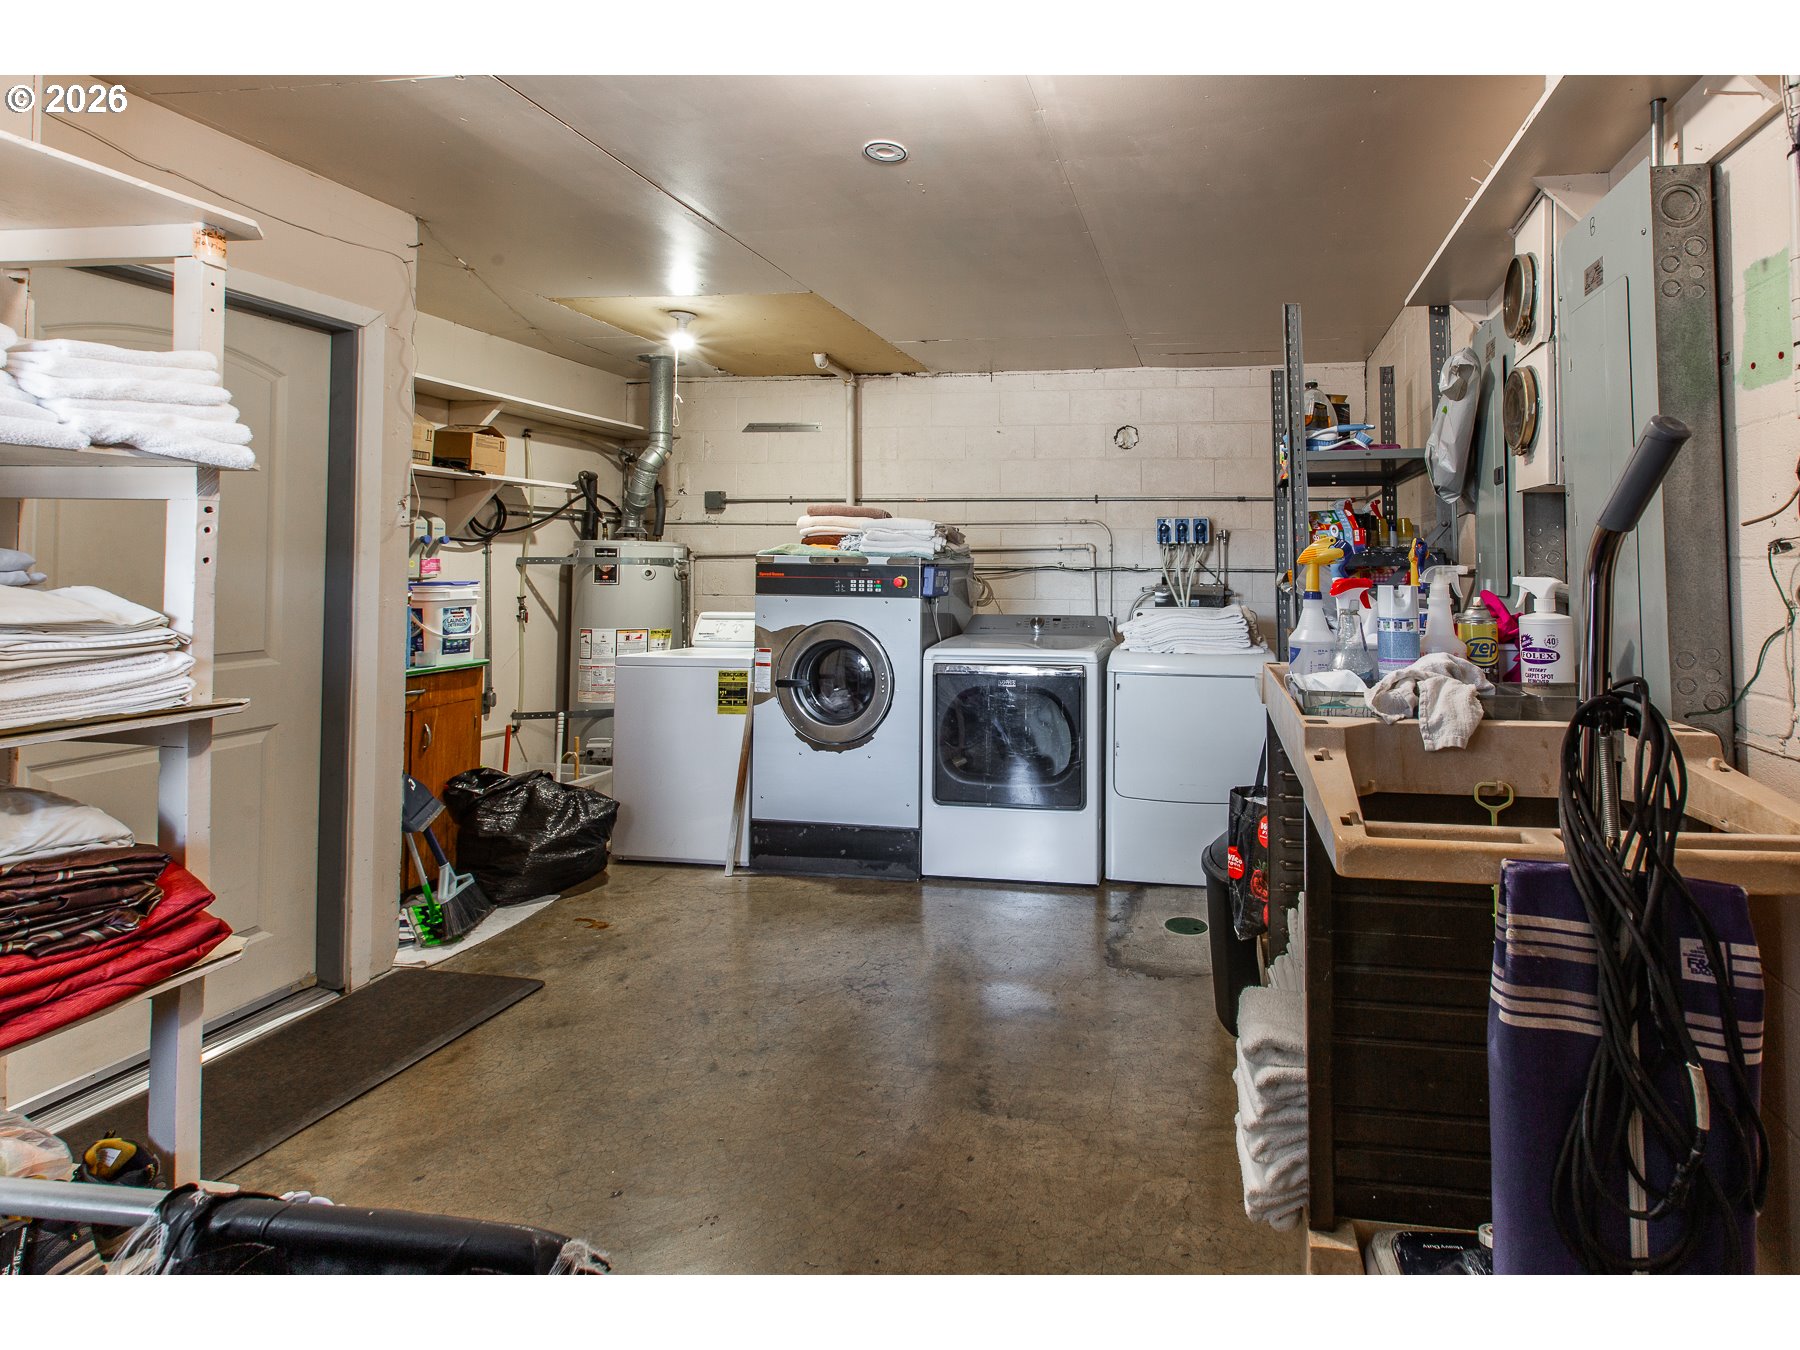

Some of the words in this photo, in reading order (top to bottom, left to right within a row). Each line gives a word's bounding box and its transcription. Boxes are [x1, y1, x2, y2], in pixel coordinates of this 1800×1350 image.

[446, 616, 469, 624] LAUNDRY
[1546, 637, 1556, 645] 40
[1522, 651, 1554, 660] FOLEX
